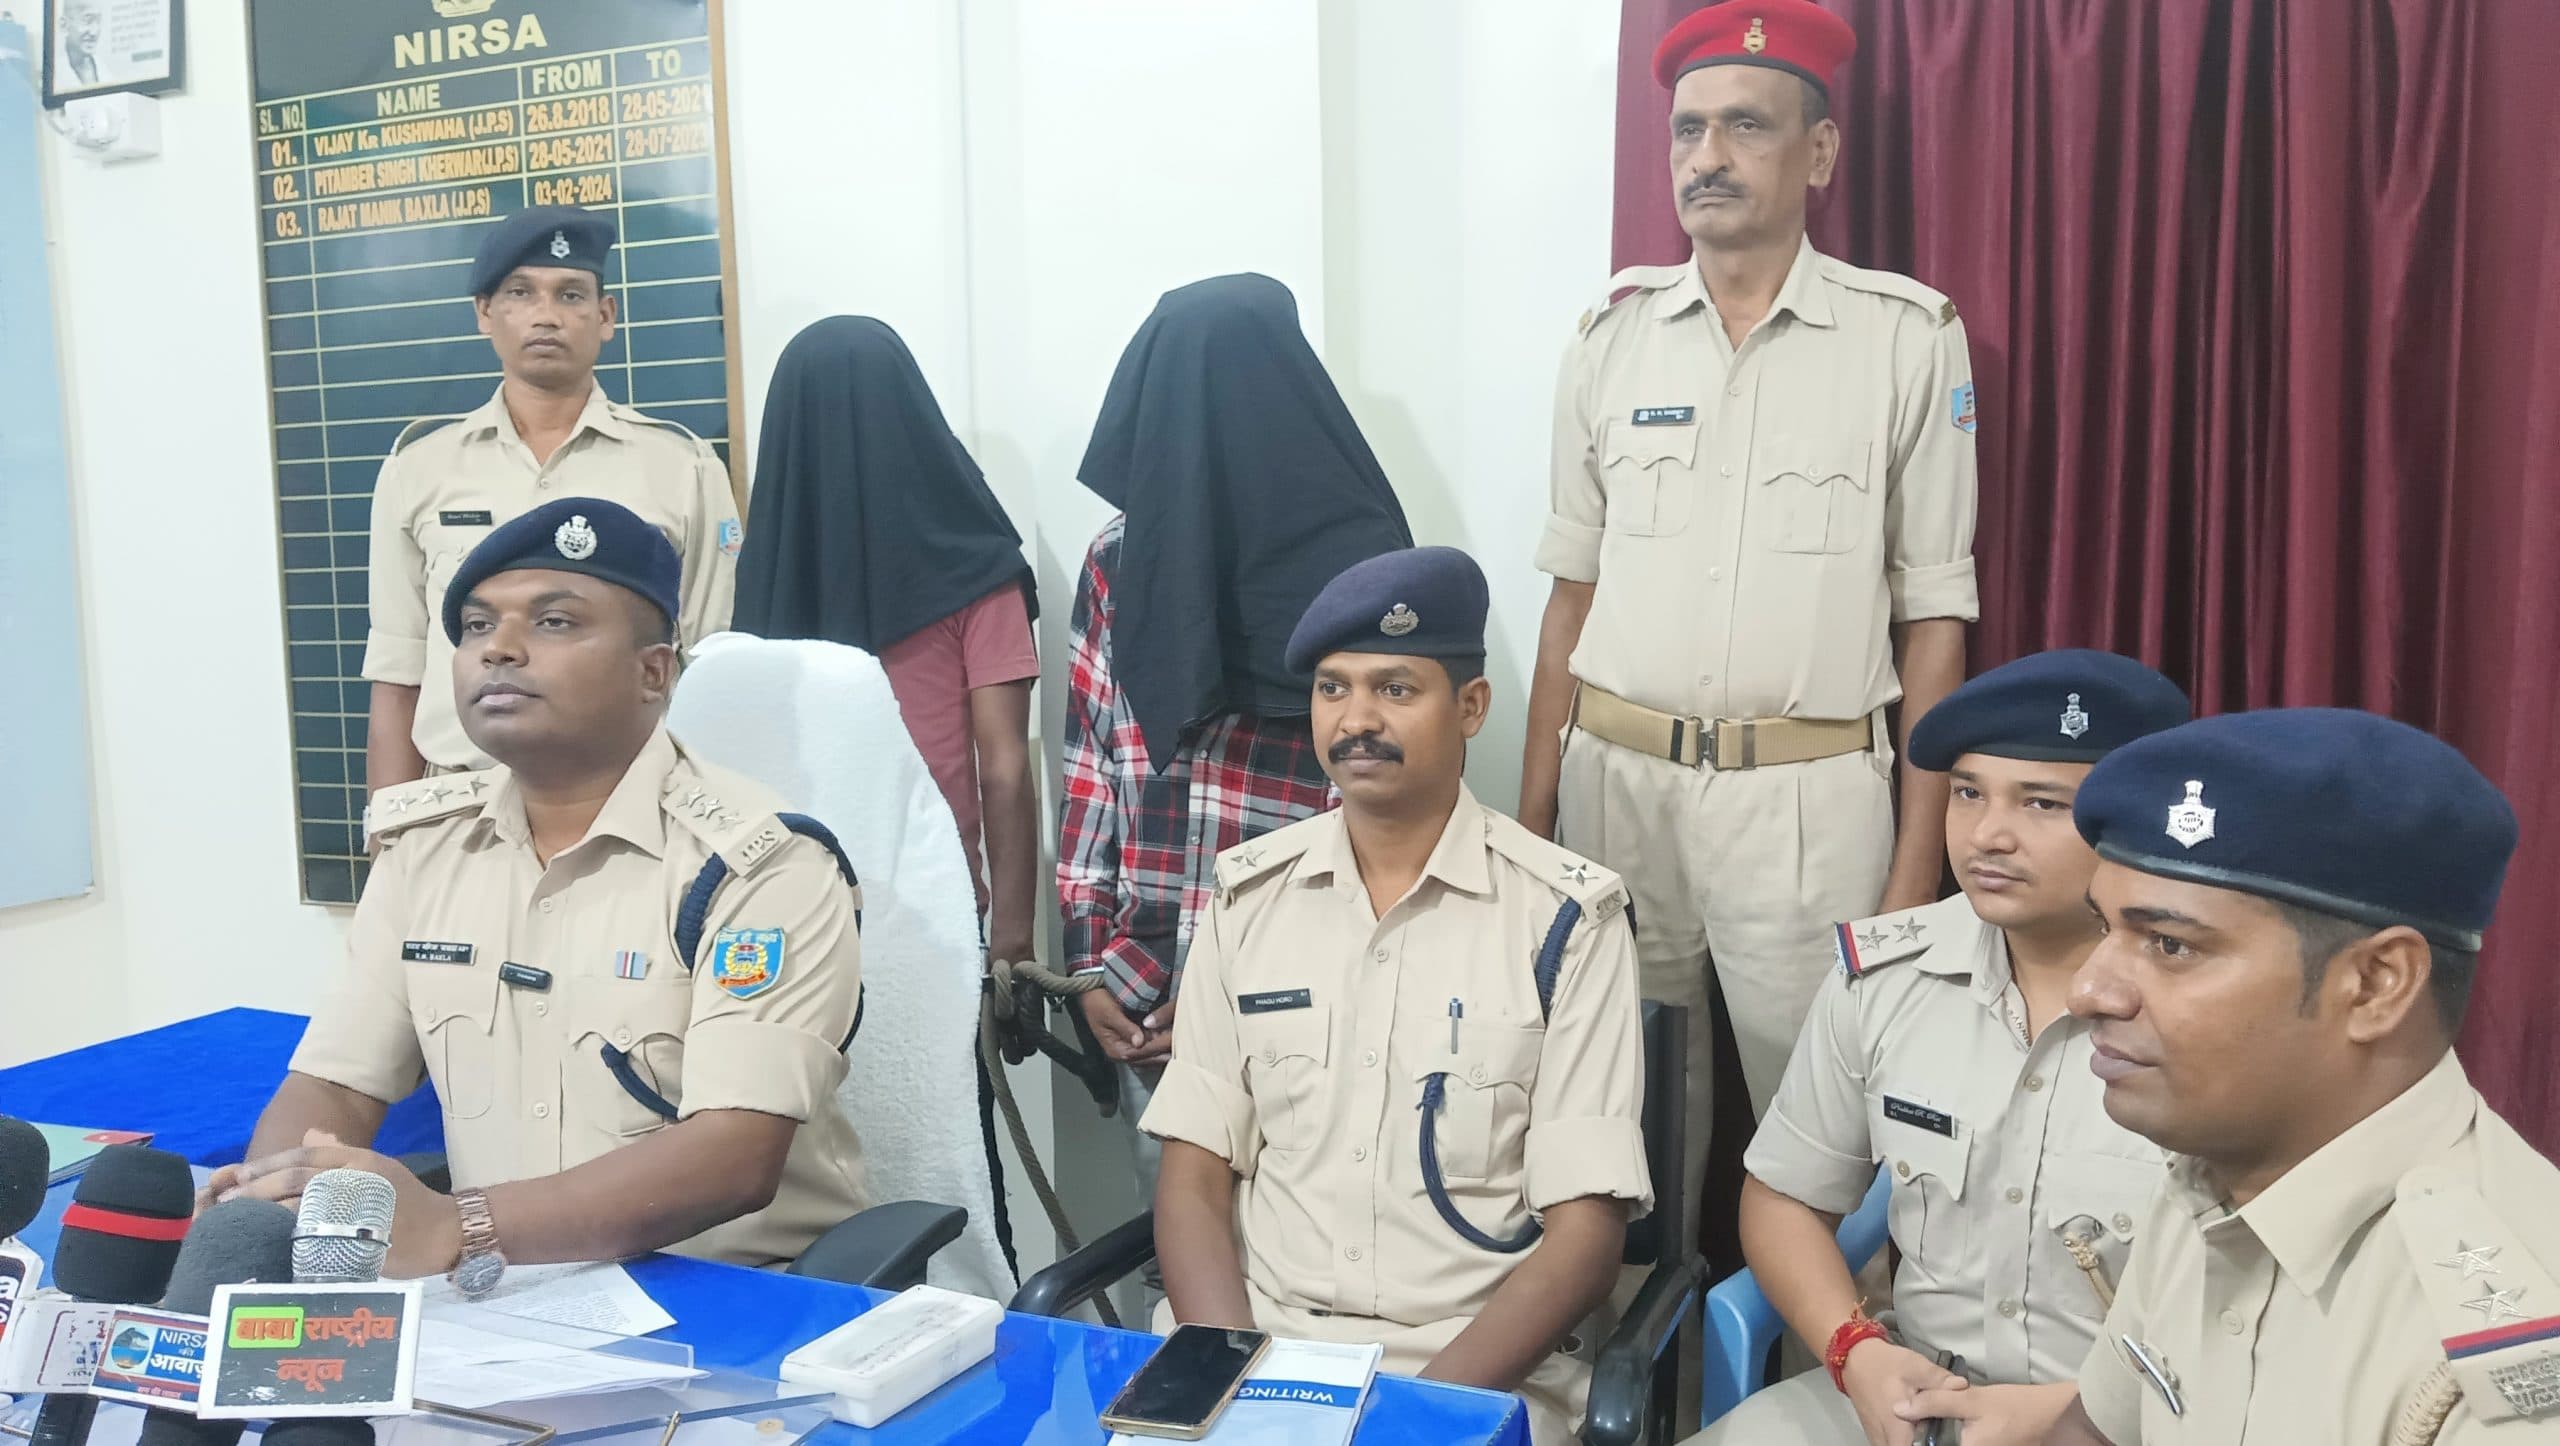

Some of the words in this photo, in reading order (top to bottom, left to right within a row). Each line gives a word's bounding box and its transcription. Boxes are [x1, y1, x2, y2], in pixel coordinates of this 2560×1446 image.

[394, 13, 548, 69] NIRSA
[532, 59, 602, 95] FROM
[646, 49, 681, 79] TO
[376, 83, 441, 117] NAME
[527, 95, 610, 133] 26.8.2018
[259, 109, 279, 134] SL.
[282, 104, 304, 131] NO.
[271, 140, 297, 168] 01.
[314, 131, 354, 157] VIJAY
[381, 117, 466, 147] KUSHWAHA
[529, 132, 613, 170] 28-05-2021
[273, 174, 299, 201] 02.
[314, 163, 376, 196] PITAMBER
[377, 157, 417, 188] SINGH
[534, 173, 612, 206] 03-02-2024
[276, 210, 302, 237] 03.
[318, 203, 357, 232] RAJAT
[359, 198, 403, 227] MANIK
[404, 192, 450, 222] BAXLA
[236, 1317, 297, 1340] बाबा
[304, 1307, 397, 1348] राष्ट्रीय
[276, 1358, 346, 1392] न्यूज
[1240, 1387, 1334, 1403] WRITING
